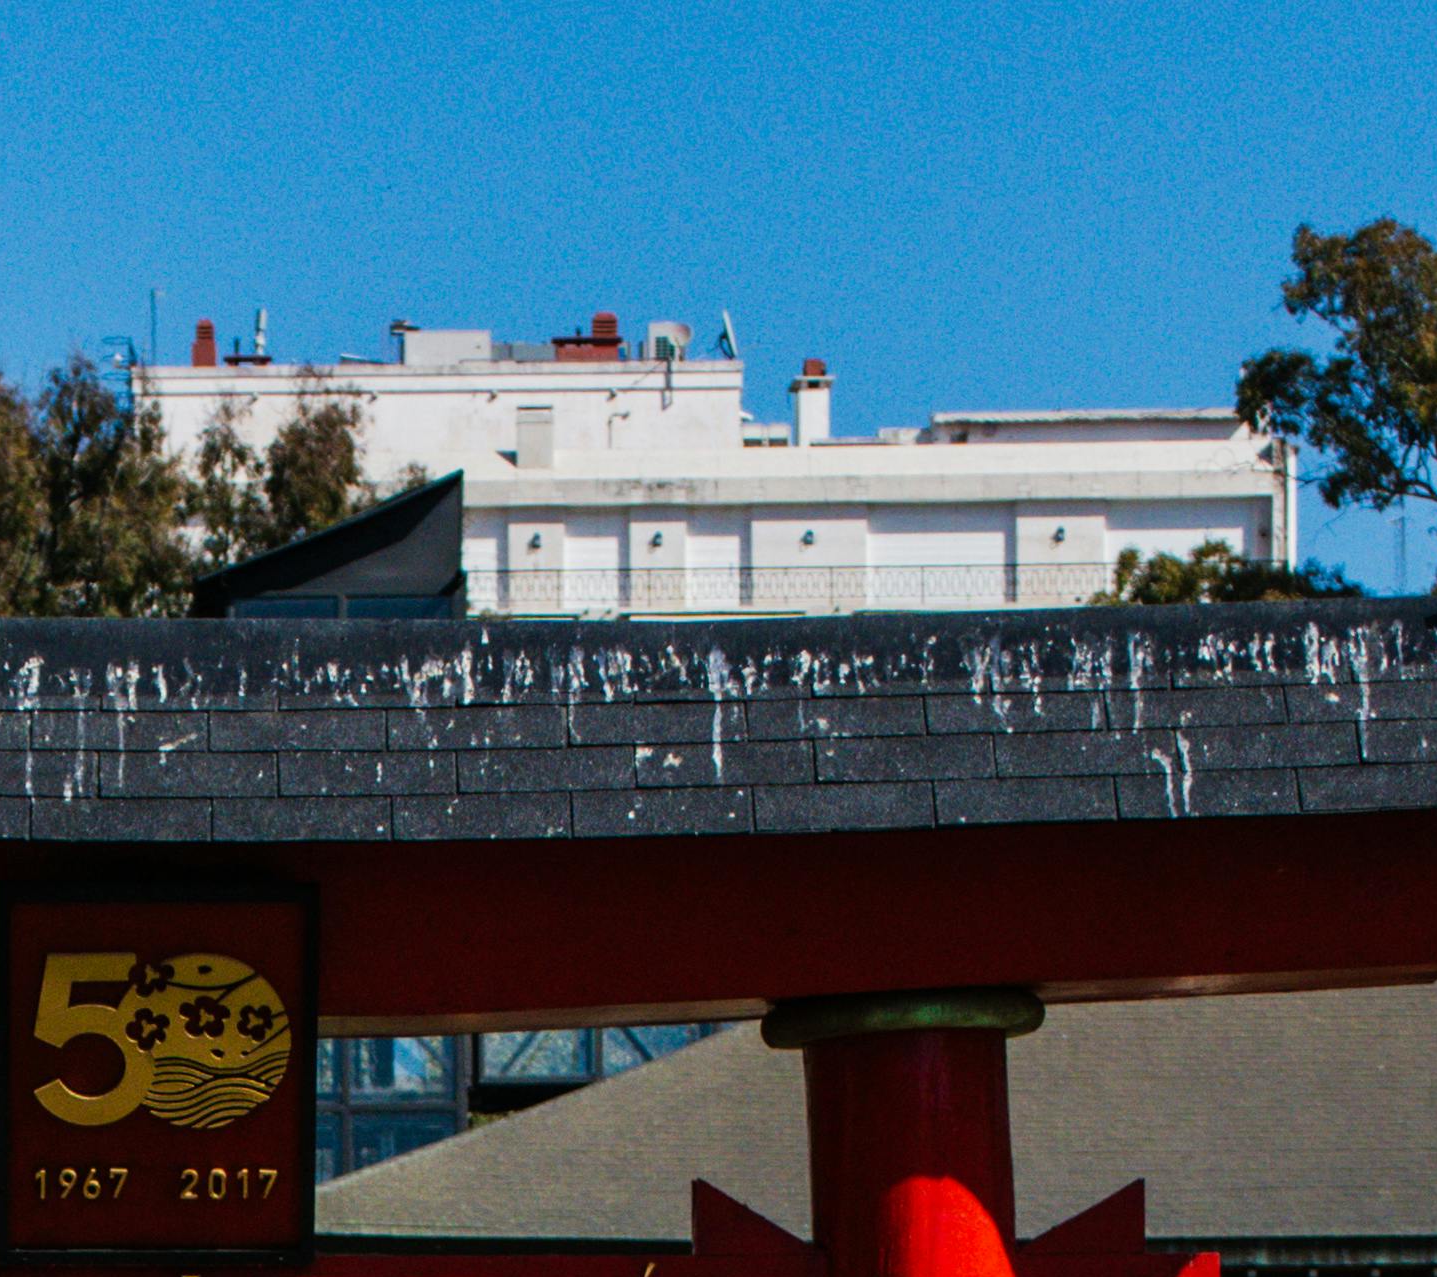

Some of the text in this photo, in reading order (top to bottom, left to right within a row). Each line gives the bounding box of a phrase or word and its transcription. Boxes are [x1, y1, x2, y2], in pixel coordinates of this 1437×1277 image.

[33, 952, 292, 1129] 50
[35, 1168, 278, 1199] 1967 2017
